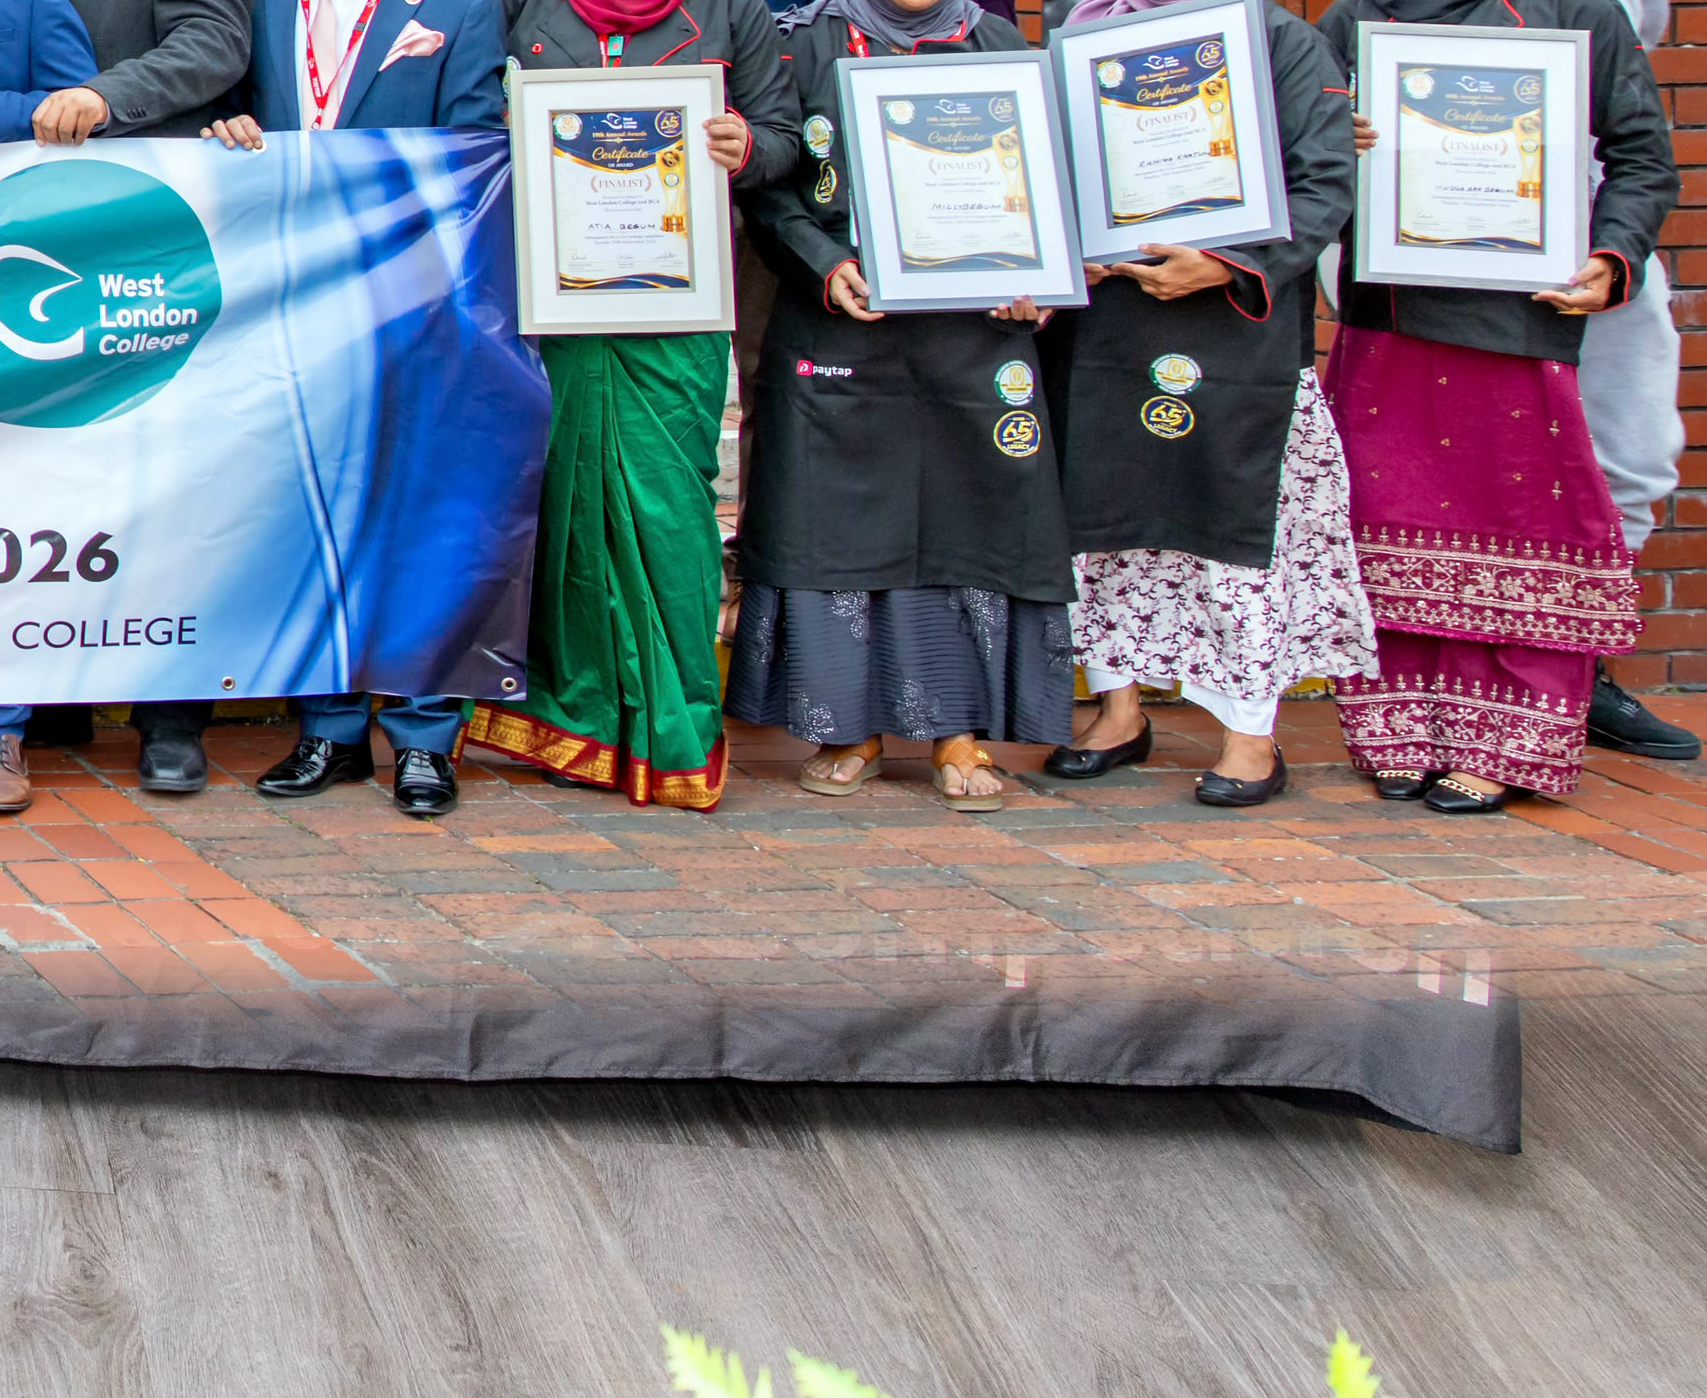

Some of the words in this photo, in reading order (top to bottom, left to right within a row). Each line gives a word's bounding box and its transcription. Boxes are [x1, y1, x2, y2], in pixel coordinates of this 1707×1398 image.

[592, 146, 649, 163] Certificate
[598, 178, 644, 190] FINALIST
[98, 272, 166, 298] West
[99, 302, 199, 329] London
[98, 332, 190, 356] College
[812, 365, 853, 377] paytap
[11, 615, 198, 651] COLLEGE
